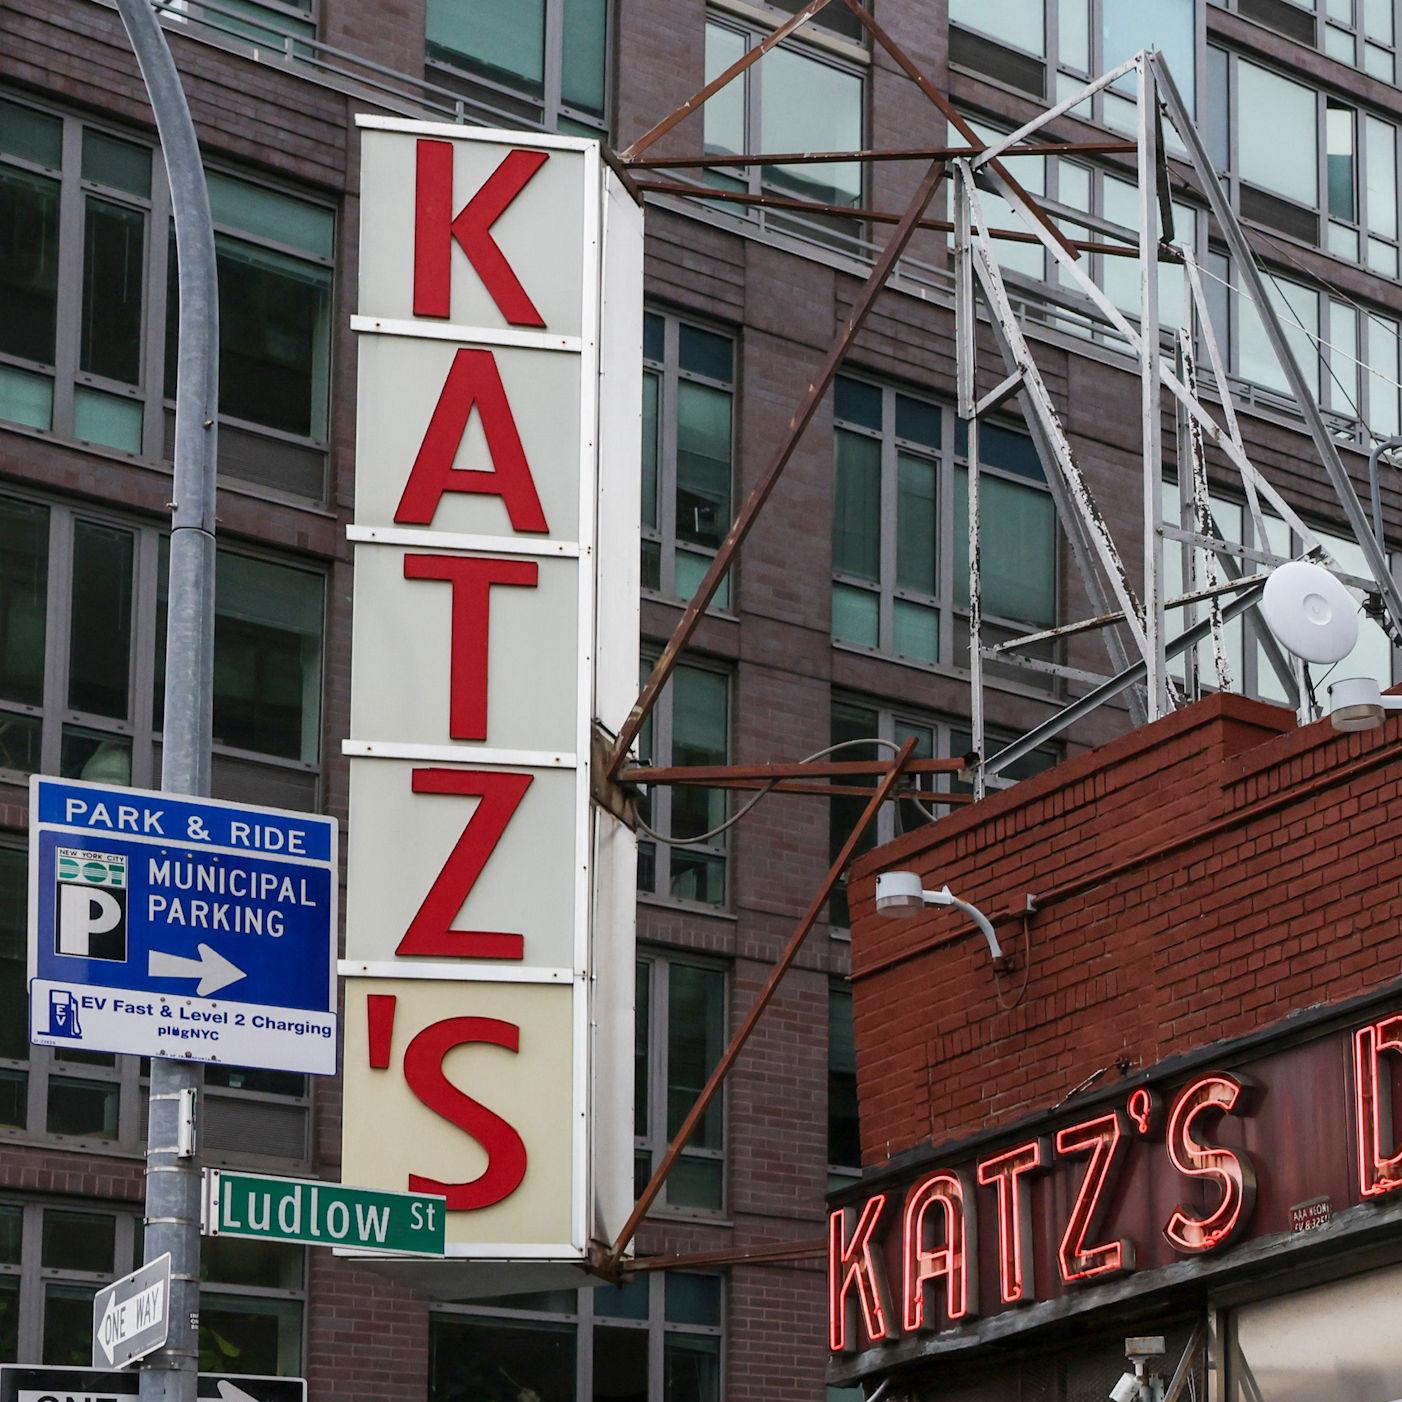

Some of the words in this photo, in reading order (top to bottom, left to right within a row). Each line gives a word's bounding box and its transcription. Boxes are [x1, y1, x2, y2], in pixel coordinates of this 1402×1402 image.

[367, 138, 550, 1212] KATZ'S
[65, 798, 165, 835] PARK
[187, 815, 212, 842] &
[230, 821, 307, 855] RIDE
[58, 849, 79, 858] NEW
[82, 851, 103, 861] YORK
[106, 854, 125, 864] CITY
[58, 857, 126, 886] DOT
[148, 857, 317, 908] MUNICIPAL
[60, 883, 123, 956] P
[147, 894, 285, 939] PARKING
[81, 995, 107, 1011] EV
[113, 999, 154, 1016] Fast
[159, 1004, 173, 1018] &
[179, 1006, 229, 1025] Level
[234, 1013, 246, 1027] 2
[251, 1015, 332, 1038] Charging
[222, 1180, 391, 1243] Ludlow
[409, 1202, 437, 1233] St
[829, 1070, 1256, 1352] KATZ'S
[104, 1305, 126, 1347] ONE
[136, 1287, 160, 1331] WAY
